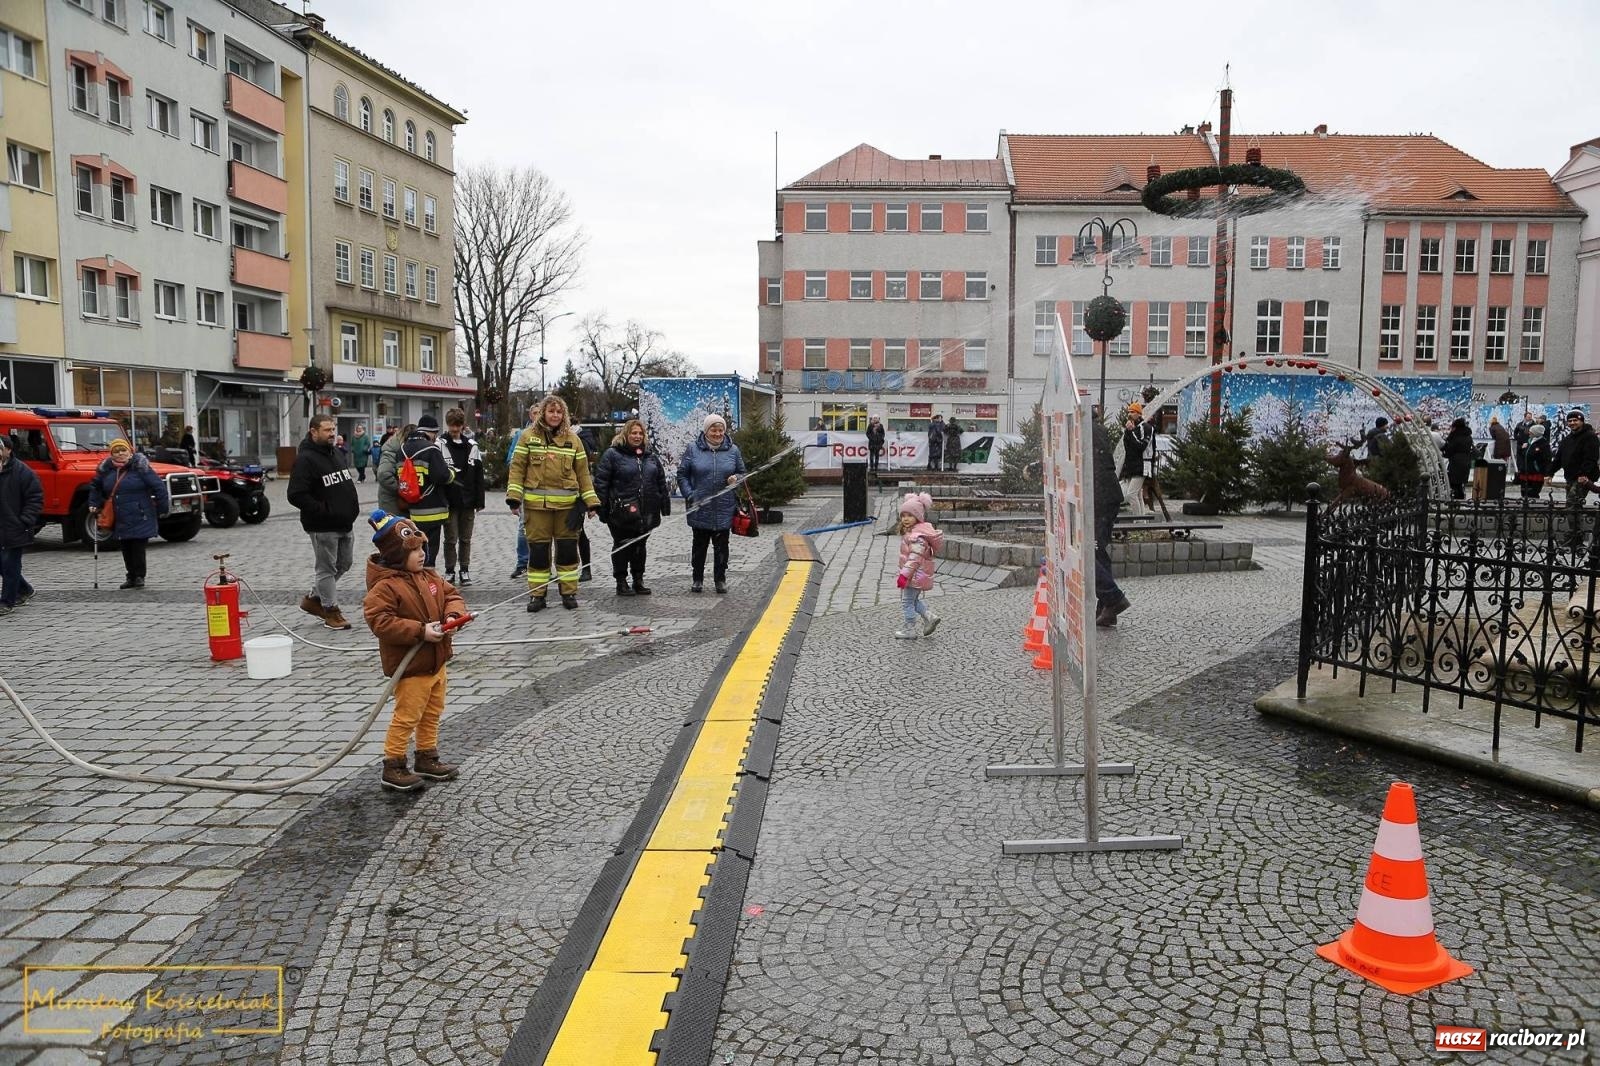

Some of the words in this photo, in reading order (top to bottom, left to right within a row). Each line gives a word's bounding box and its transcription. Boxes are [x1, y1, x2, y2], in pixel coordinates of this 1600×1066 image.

[365, 369, 376, 378] TEB
[422, 373, 459, 387] ROSSMANN
[911, 377, 988, 390] zaprasza
[833, 442, 917, 458] Racórz
